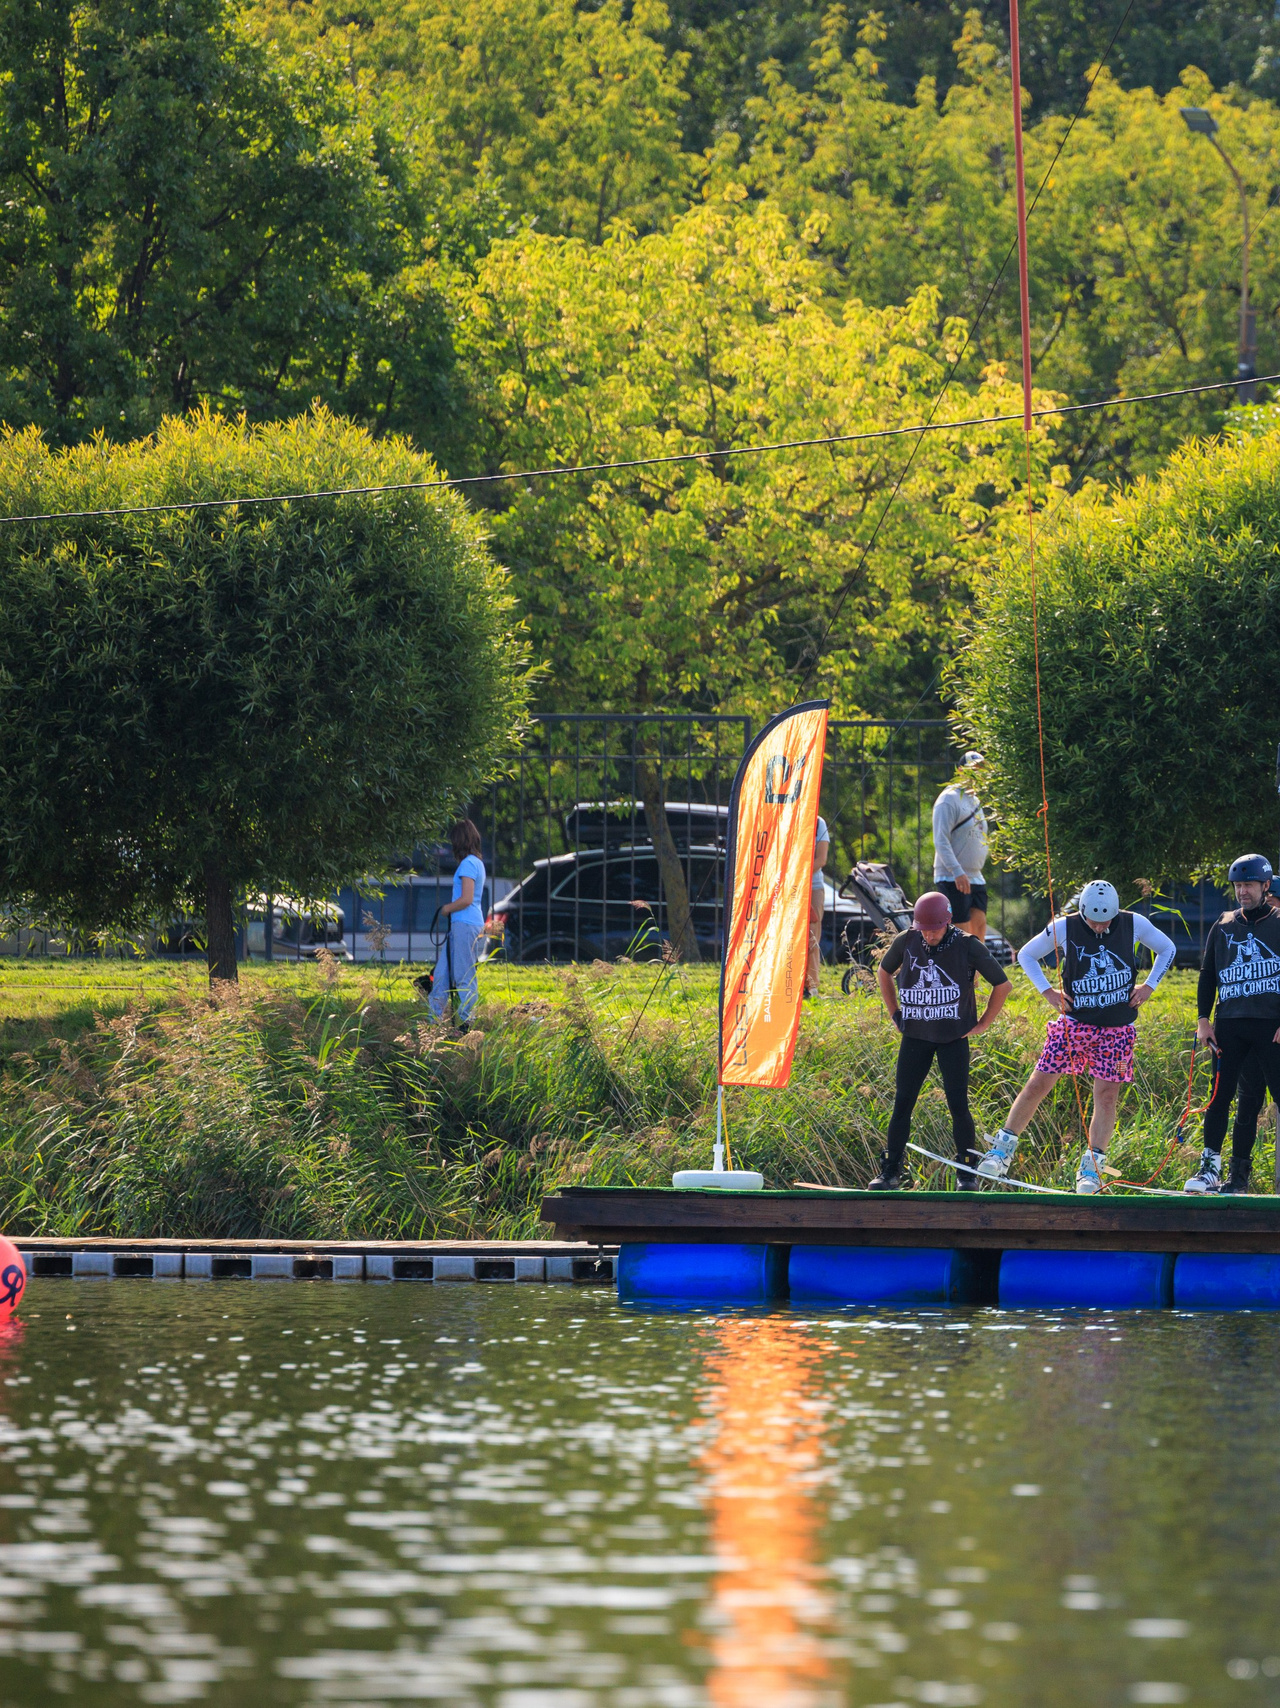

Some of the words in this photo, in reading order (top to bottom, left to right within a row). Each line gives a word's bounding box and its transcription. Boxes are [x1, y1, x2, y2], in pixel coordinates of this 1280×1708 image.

[737, 830, 770, 995] RAKETOS
[768, 870, 782, 937] ТРИМА
[1218, 960, 1280, 983] KUPCHINO
[899, 987, 960, 1005] KUPCHINO
[1073, 995, 1097, 1009] OPEN
[1098, 986, 1130, 1008] CONTEST
[1219, 984, 1242, 1001] OPEN
[923, 1002, 960, 1021] CONTEST
[732, 1002, 750, 1067] LOS
